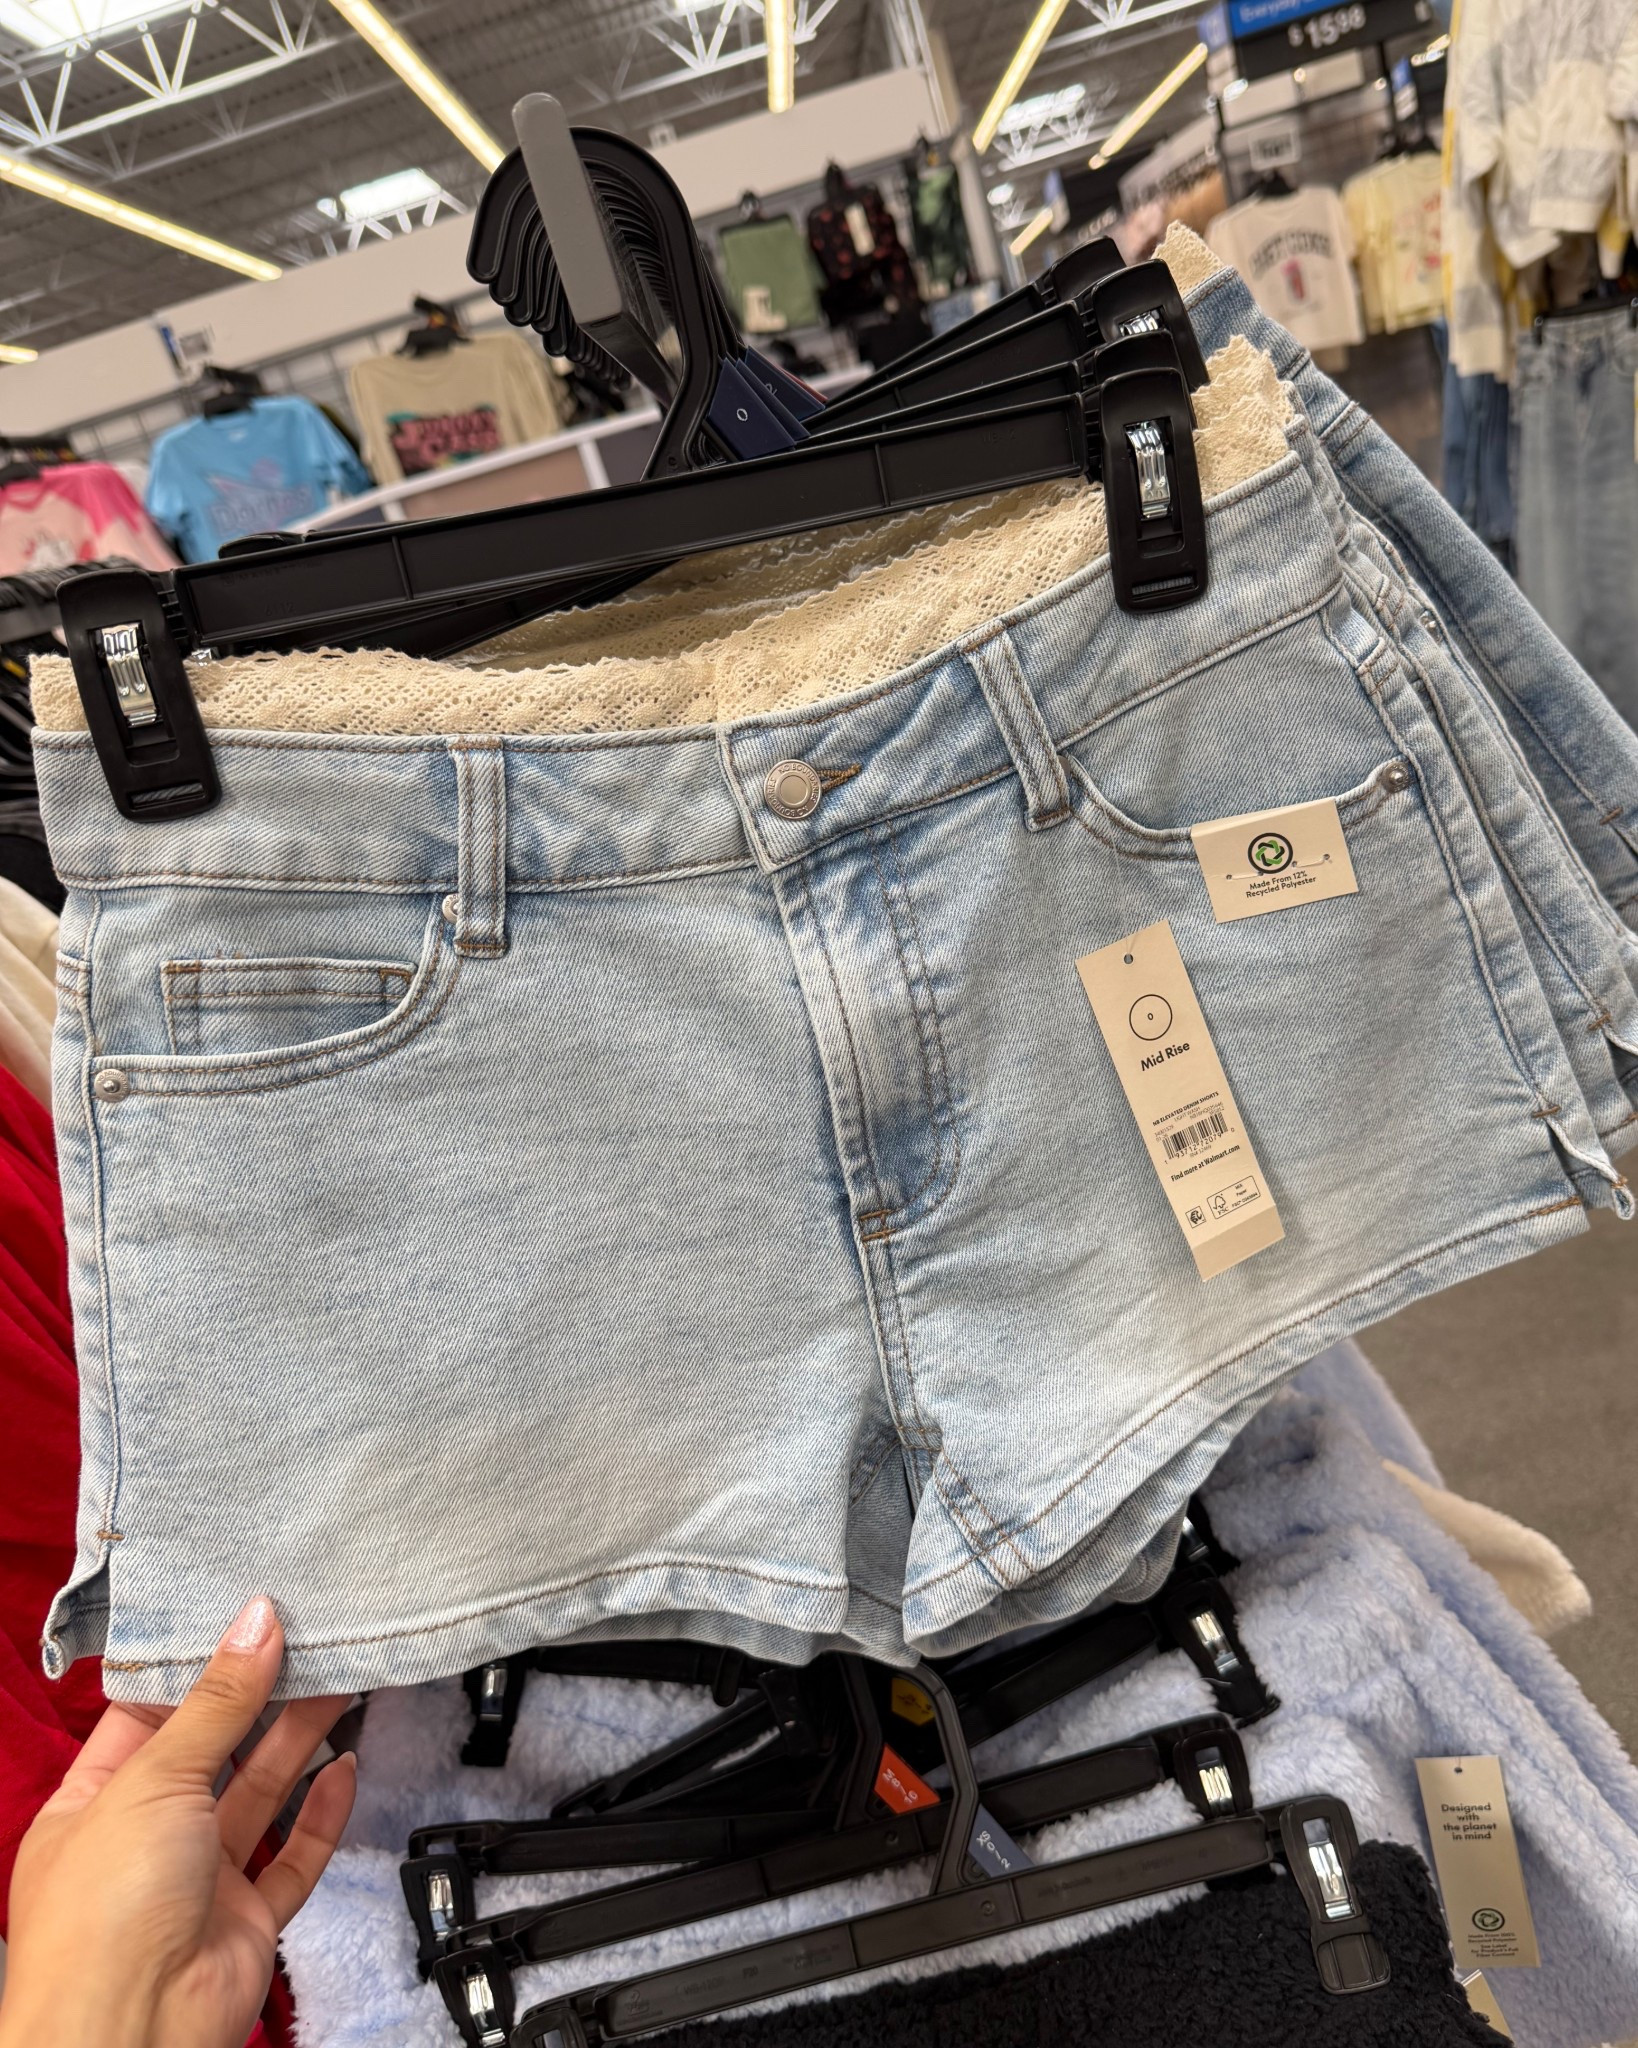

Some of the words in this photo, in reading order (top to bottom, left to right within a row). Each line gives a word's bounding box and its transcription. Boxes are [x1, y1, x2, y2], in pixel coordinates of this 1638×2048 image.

[1246, 884, 1280, 898] Recycled
[1281, 877, 1316, 890] Polyester
[1249, 880, 1271, 890] Made
[1271, 875, 1292, 885] From
[1141, 1050, 1164, 1072] Mid
[1165, 1042, 1190, 1059] Rise
[1160, 1107, 1183, 1122] ELEVATED
[1183, 1100, 1200, 1111] DENIM
[1199, 1091, 1219, 1103] SHORTS
[1171, 1170, 1184, 1182] Find
[1183, 1165, 1198, 1176] more
[1198, 1161, 1205, 1169] at
[1203, 1144, 1241, 1166] Walmart.com
[1441, 1802, 1491, 1813] Designed
[1456, 1812, 1480, 1821] with
[1443, 1822, 1460, 1831] the
[1462, 1822, 1497, 1832] planet
[1452, 1832, 1463, 1840] in
[1464, 1831, 1491, 1840] mind
